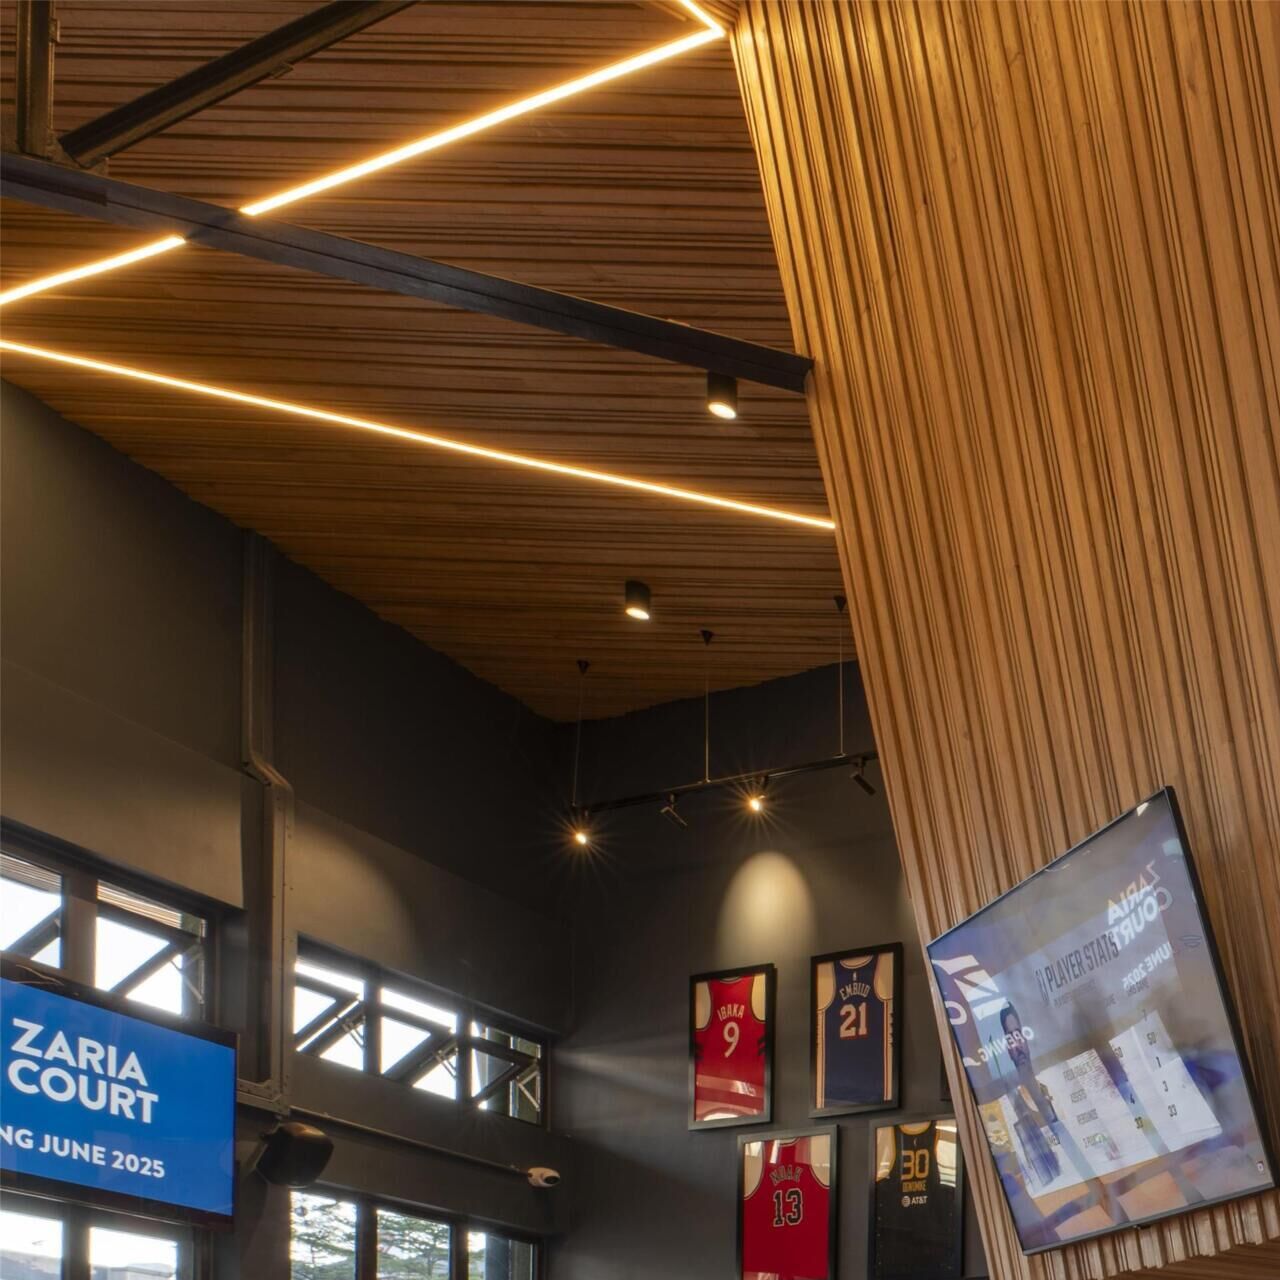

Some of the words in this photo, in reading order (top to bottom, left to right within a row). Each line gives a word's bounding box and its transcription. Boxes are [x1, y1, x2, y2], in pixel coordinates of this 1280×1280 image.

[1044, 948, 1087, 993] PLAYER
[1083, 931, 1120, 972] STATS
[716, 1003, 745, 1022] IBAKA
[840, 1001, 868, 1039] 21
[11, 1017, 149, 1087] ZARIA
[723, 1021, 740, 1058] 9
[8, 1058, 159, 1124] COURT
[39, 1133, 107, 1166] JUNE
[111, 1150, 166, 1179] 2025
[901, 1148, 930, 1180] 30
[773, 1187, 804, 1227] 13
[911, 1194, 929, 1206] AT&T
